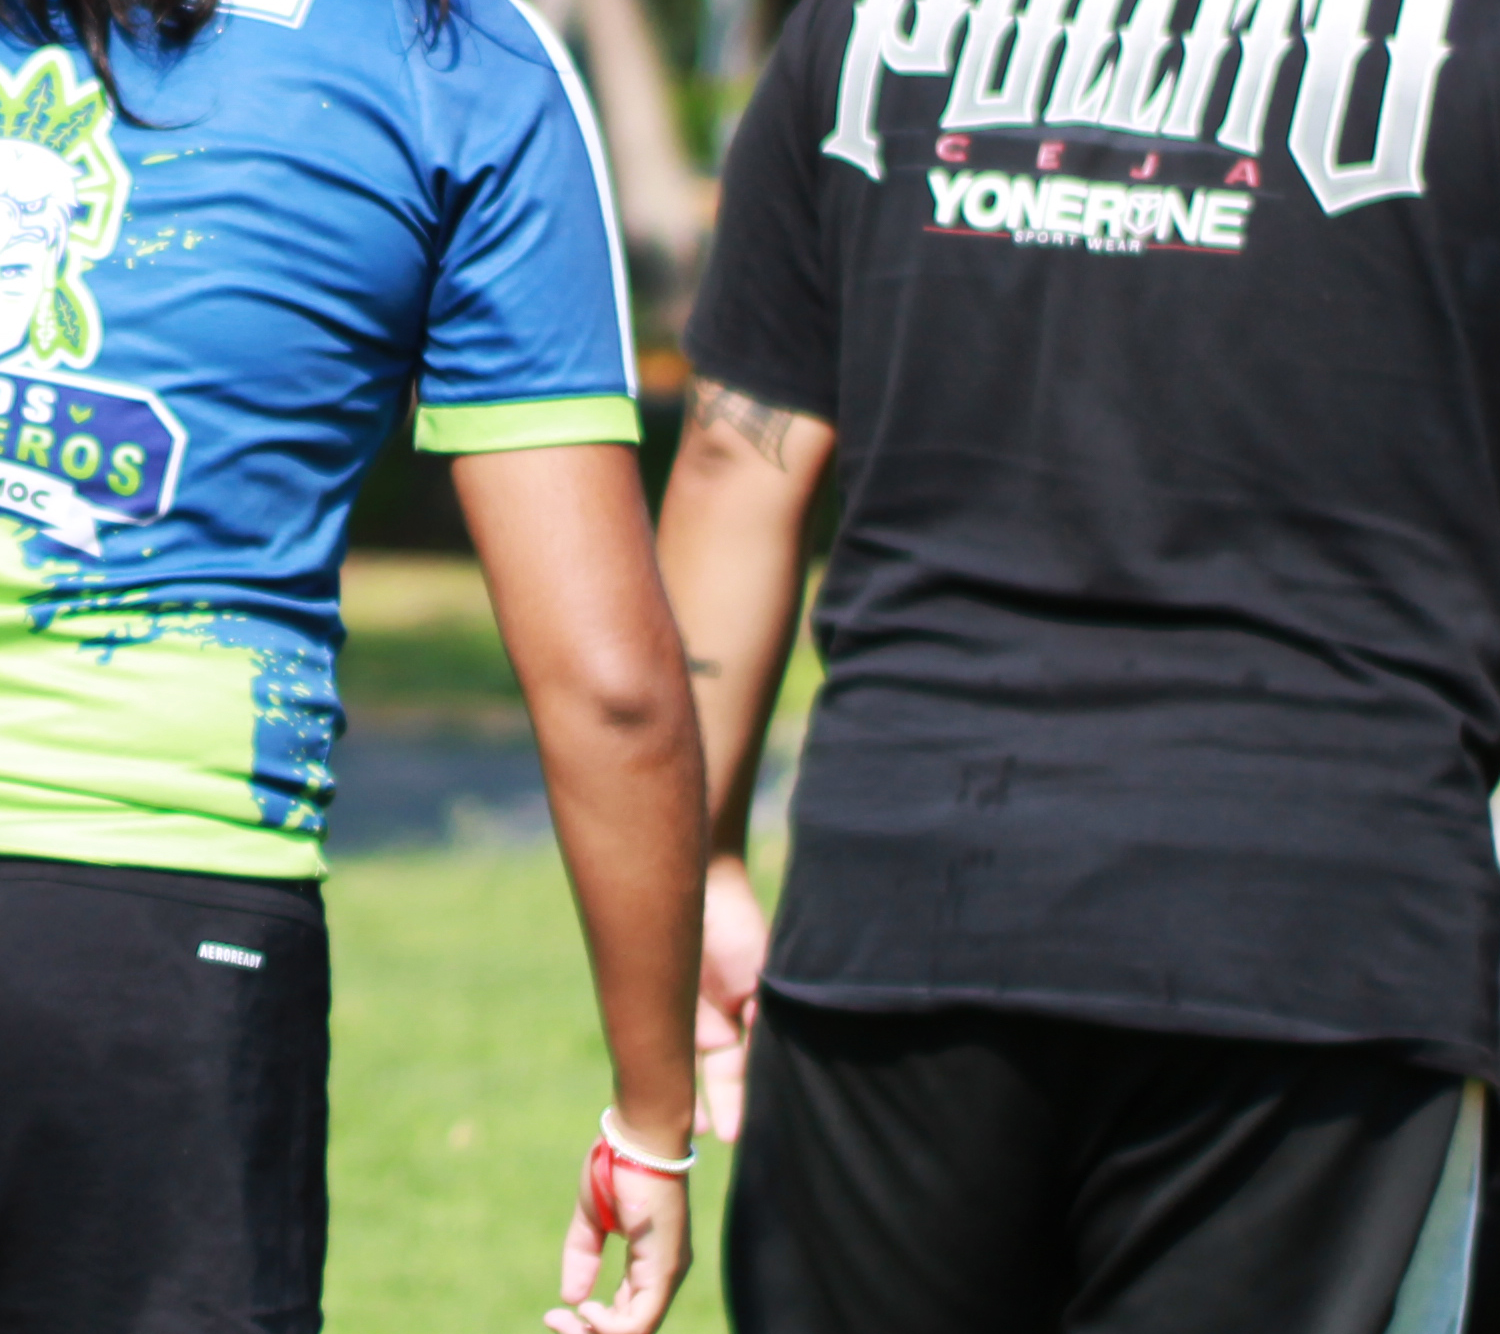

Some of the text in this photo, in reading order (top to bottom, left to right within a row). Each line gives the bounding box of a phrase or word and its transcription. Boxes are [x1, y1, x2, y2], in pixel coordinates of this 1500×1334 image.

[936, 134, 1262, 188] CEJA
[1014, 230, 1142, 252] SPORT WEAR
[200, 943, 262, 968] AEROREADY
